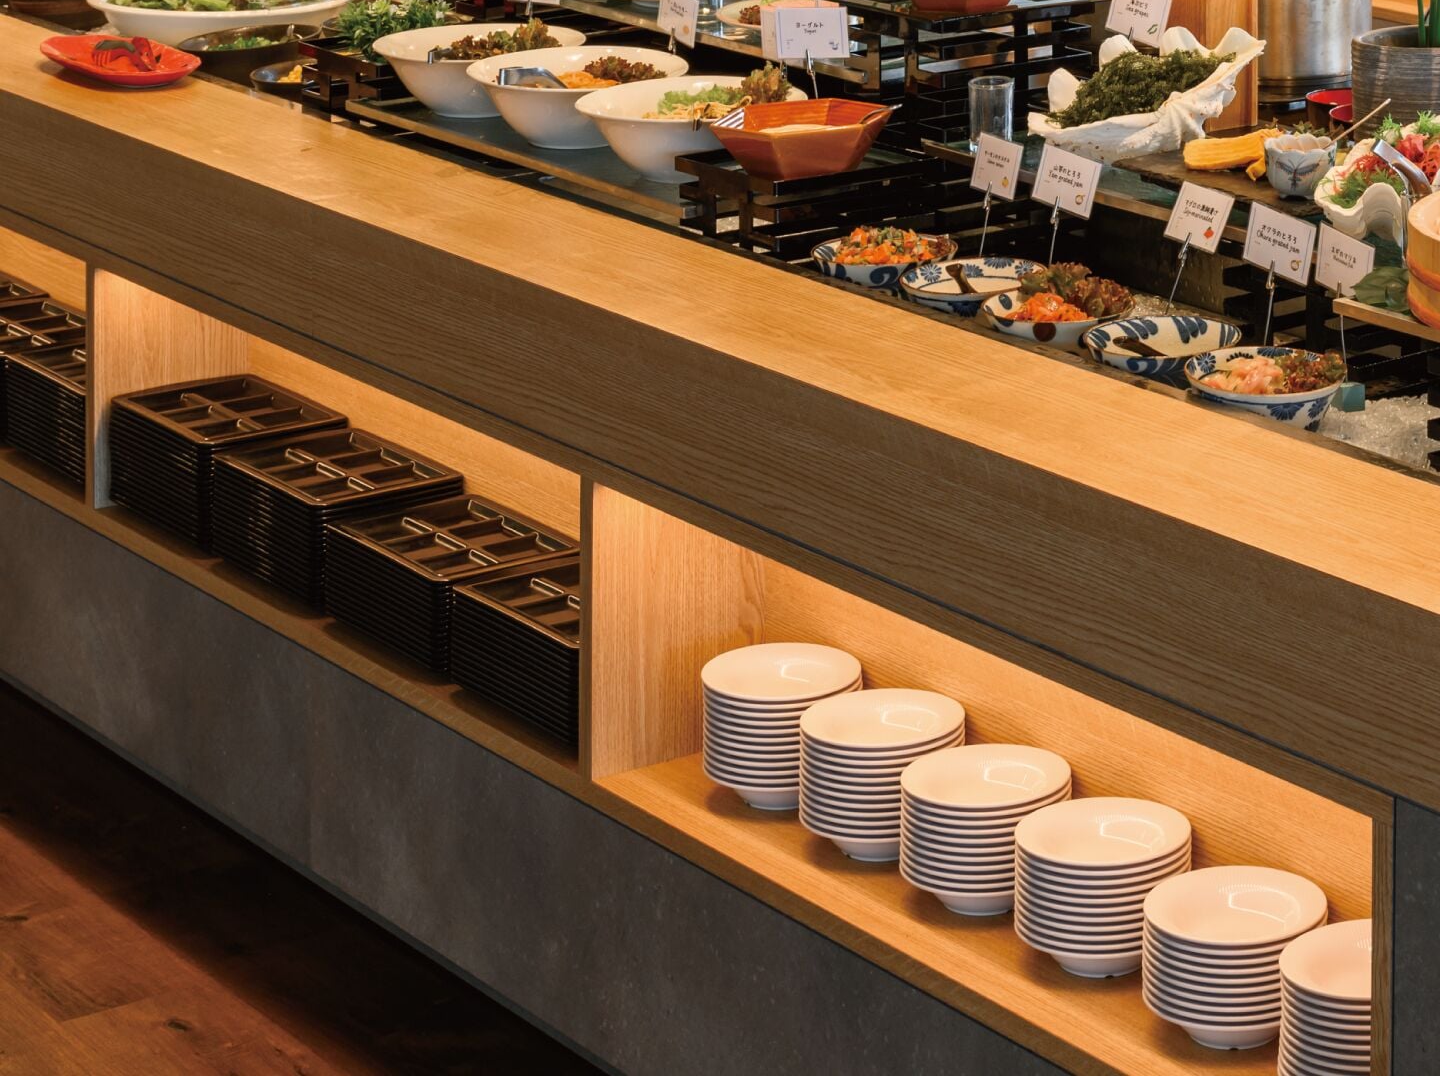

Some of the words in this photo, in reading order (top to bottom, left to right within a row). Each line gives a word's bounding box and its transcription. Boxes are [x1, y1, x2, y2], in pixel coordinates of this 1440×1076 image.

[1053, 165, 1081, 179] 山芋のとろろ
[1058, 175, 1073, 184] grated
[1261, 224, 1297, 244] オクラのとろろ
[1271, 237, 1290, 250] grated
